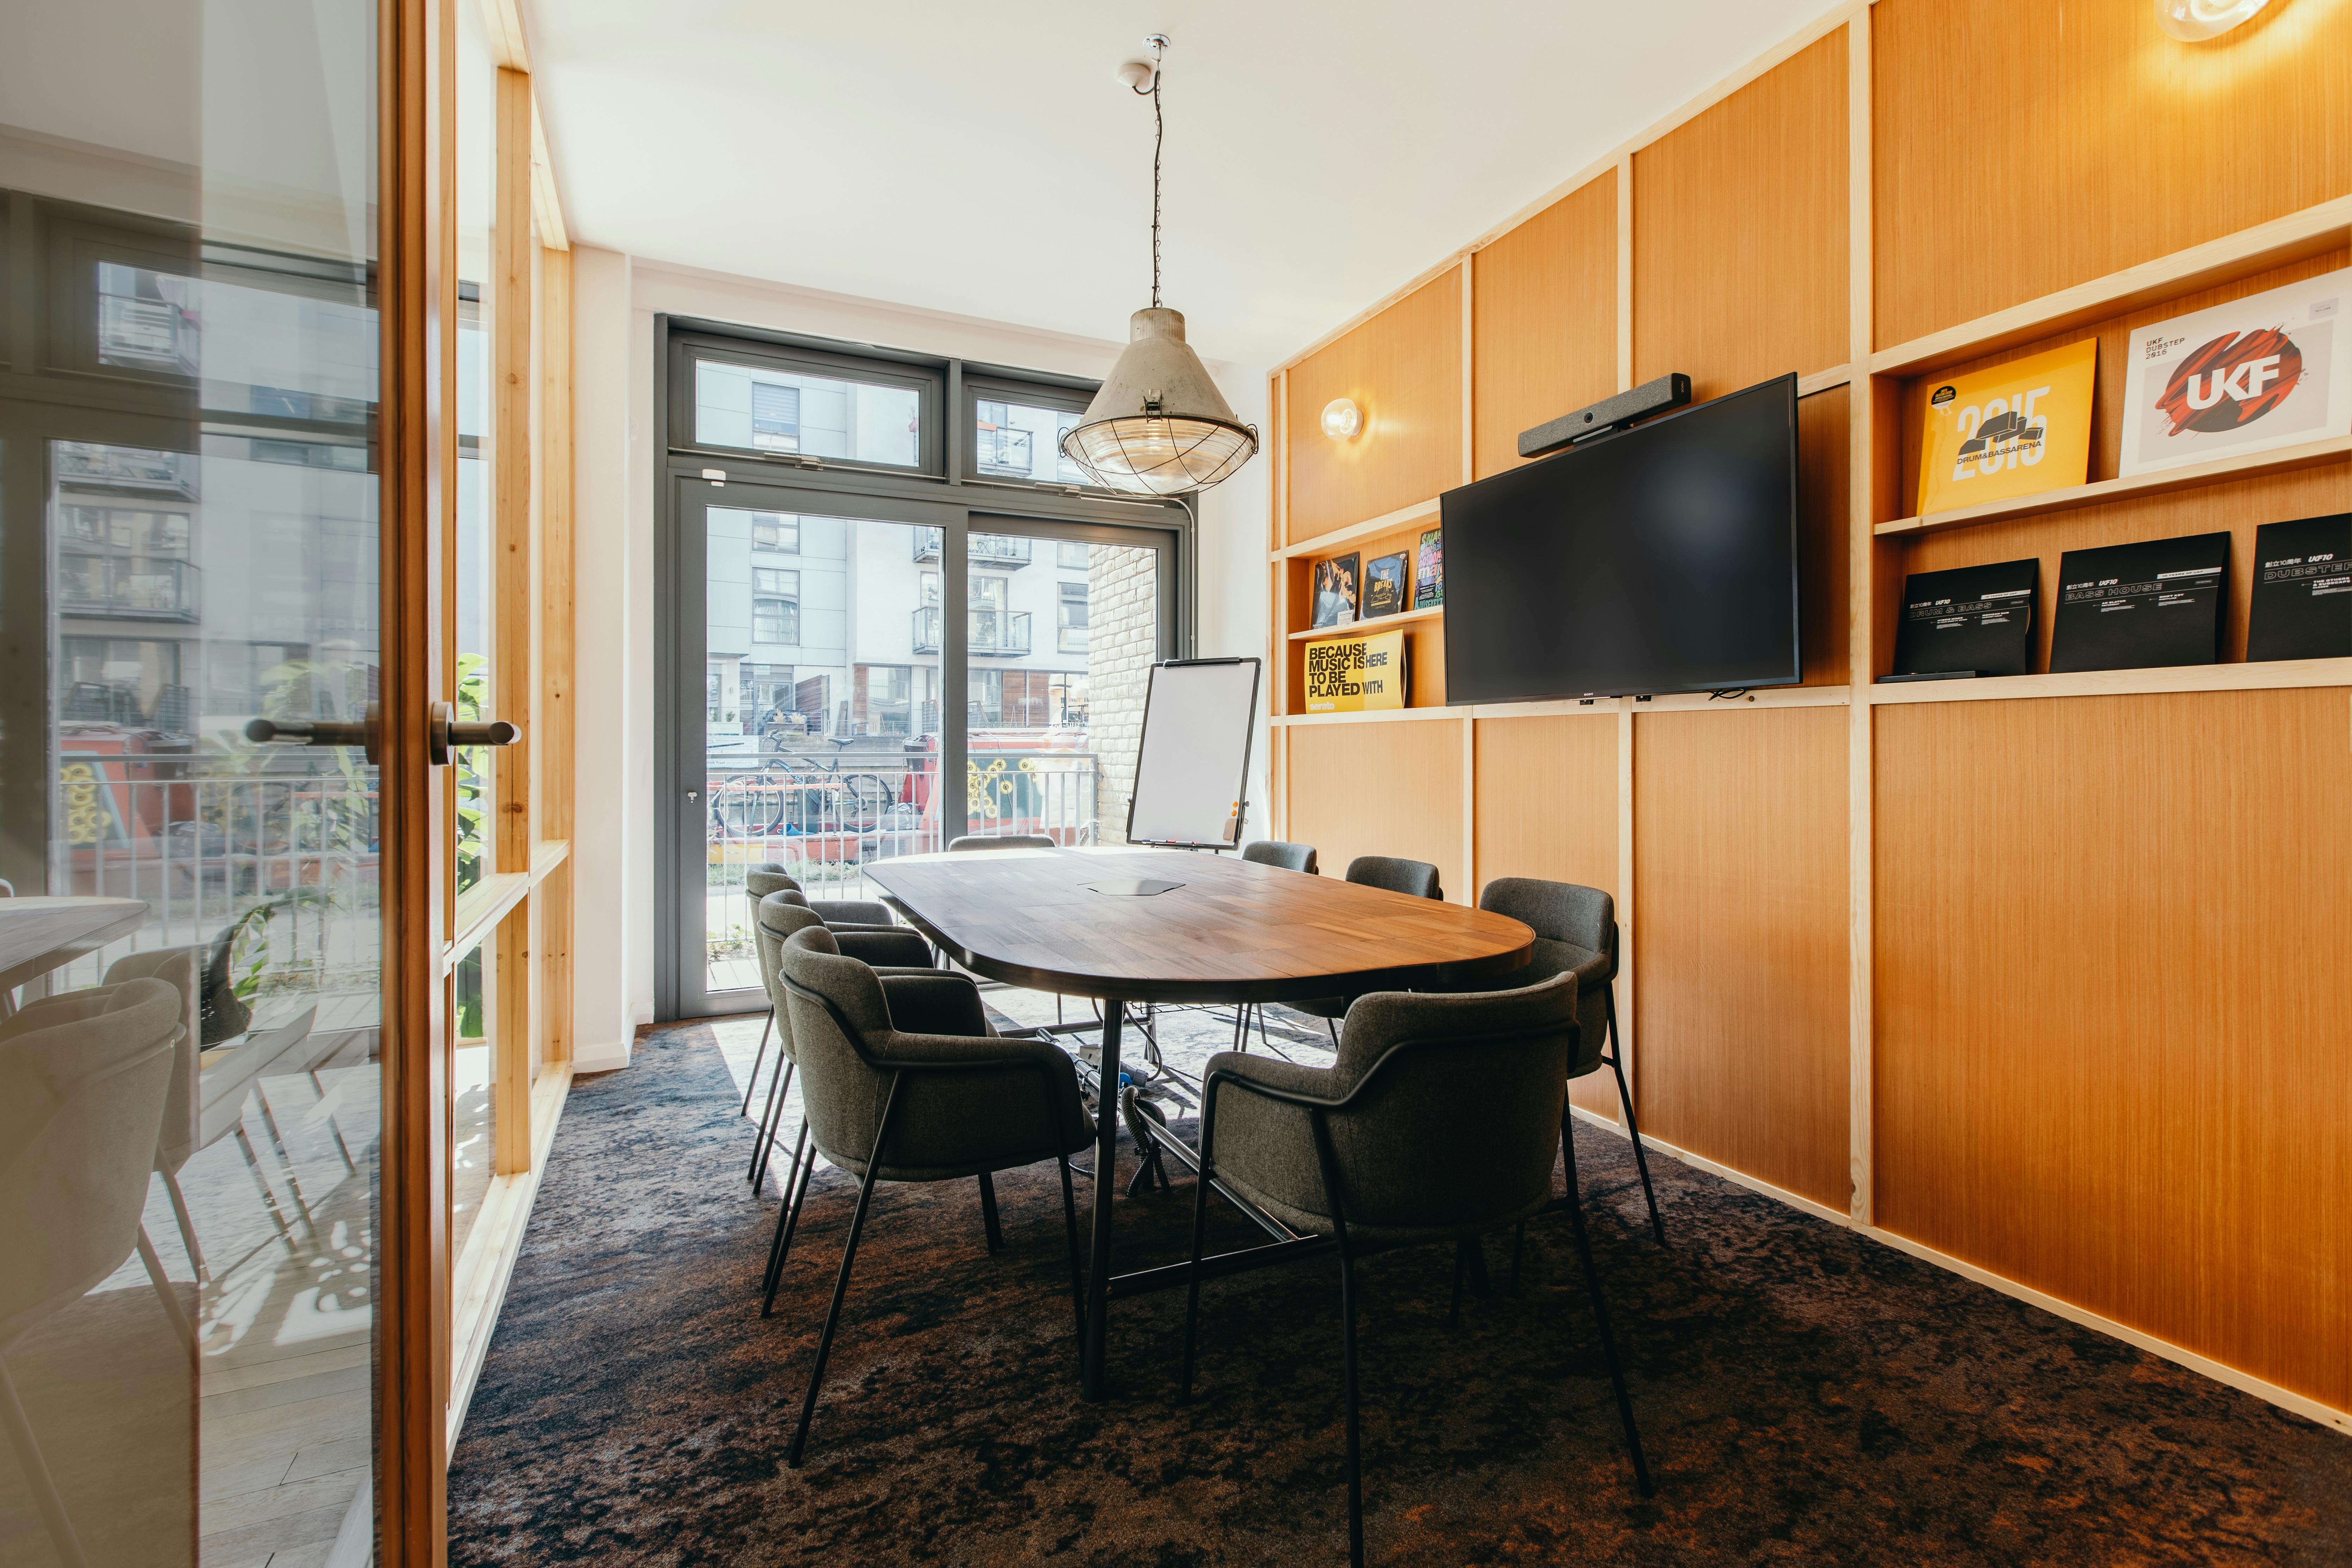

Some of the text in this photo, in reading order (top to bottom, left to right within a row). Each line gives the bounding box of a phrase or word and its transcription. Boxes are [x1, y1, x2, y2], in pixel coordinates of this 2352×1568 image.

[2146, 338, 2185, 353] DUBSTEP
[2147, 337, 2163, 346] UKF
[2145, 349, 2167, 359] 2016
[2186, 354, 2281, 410] UKF
[1953, 386, 2050, 481] 2015
[1957, 441, 2041, 465] DRUM&BASSARENA
[2308, 554, 2334, 562] UKF10
[1381, 569, 1390, 580] THE
[1374, 579, 1393, 592] BREAKS
[2065, 583, 2163, 600] BASS HOUSE
[1909, 608, 1943, 618] DRUM
[1958, 602, 1992, 612] BASS
[1309, 643, 1367, 660] BECAUSE
[1309, 652, 1387, 672] MUSIC IS HERE
[1309, 670, 1346, 685] TO BE
[1309, 680, 1383, 698] PLAYED WITH
[1310, 702, 1335, 711] serato
